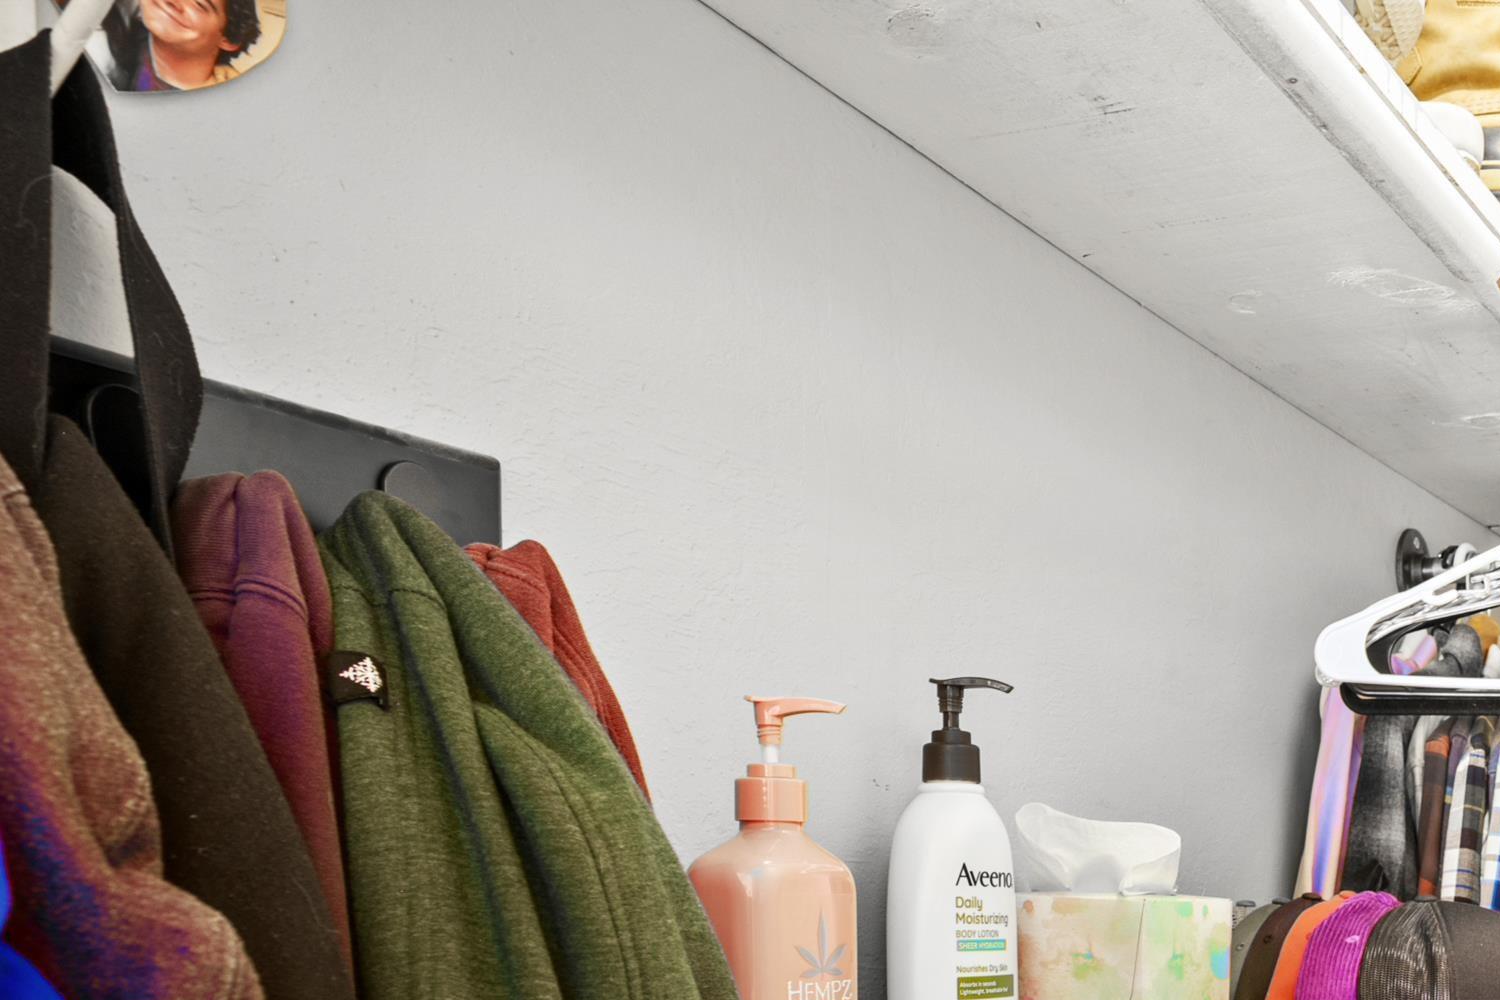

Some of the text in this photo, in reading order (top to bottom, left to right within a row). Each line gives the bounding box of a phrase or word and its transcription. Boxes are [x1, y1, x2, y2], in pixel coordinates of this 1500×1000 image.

[955, 861, 1012, 889] Aveeno
[955, 896, 983, 911] Daily
[955, 912, 1008, 927] Moisturizing
[955, 929, 999, 938] BODY LOTION
